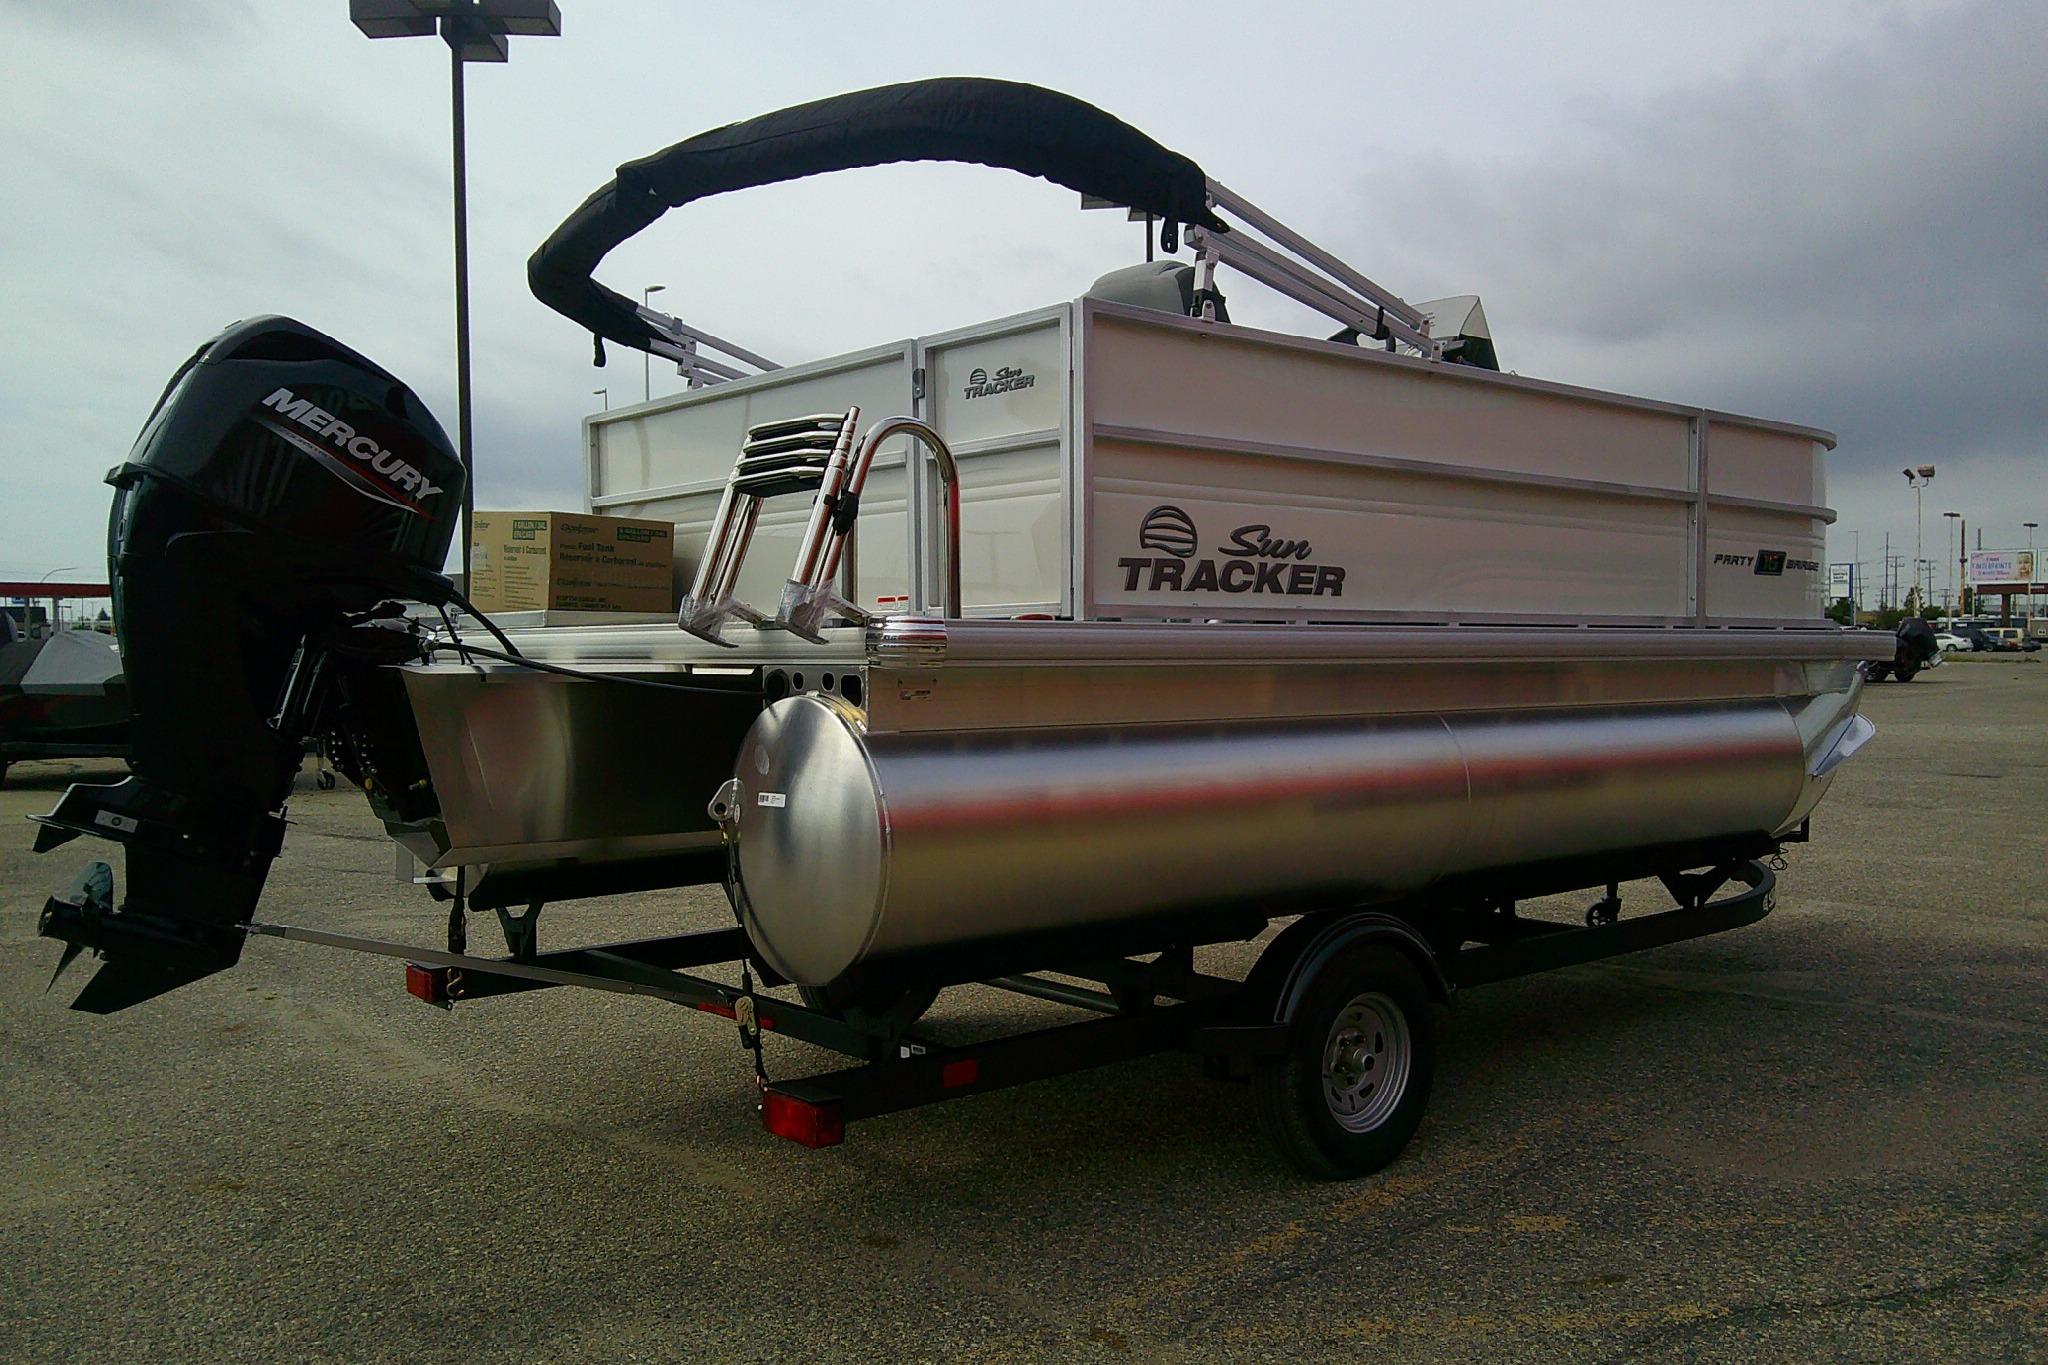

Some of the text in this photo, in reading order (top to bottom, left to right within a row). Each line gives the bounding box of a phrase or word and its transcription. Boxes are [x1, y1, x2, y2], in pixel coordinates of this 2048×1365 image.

[964, 375, 1035, 400] TRACKER
[992, 367, 1022, 381] Sun
[261, 387, 444, 500] MERCURY
[1217, 524, 1312, 560] Sun
[1713, 553, 1754, 567] PARTY
[1117, 557, 1346, 597] TRACKER
